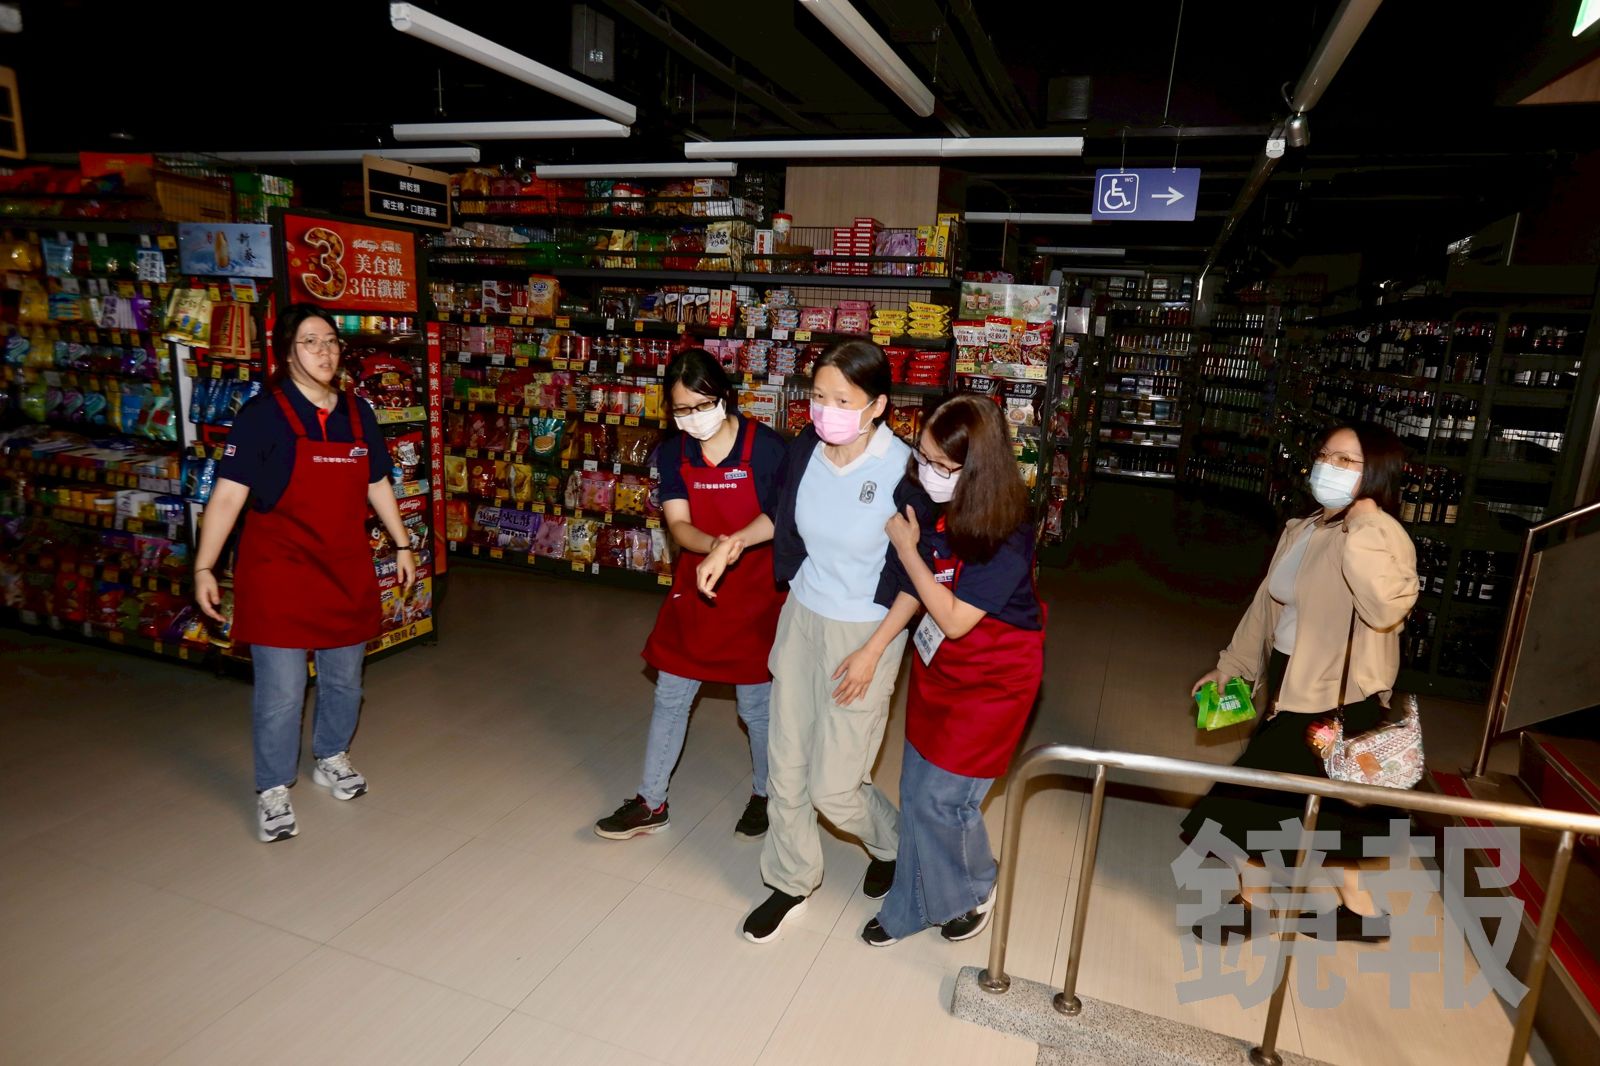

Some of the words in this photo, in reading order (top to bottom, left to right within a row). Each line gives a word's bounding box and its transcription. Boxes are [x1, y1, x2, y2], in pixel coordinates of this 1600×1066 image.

[408, 166, 413, 176] 7
[399, 181, 421, 194] 餅乾類
[355, 253, 404, 277] 美食級
[859, 480, 878, 505] G
